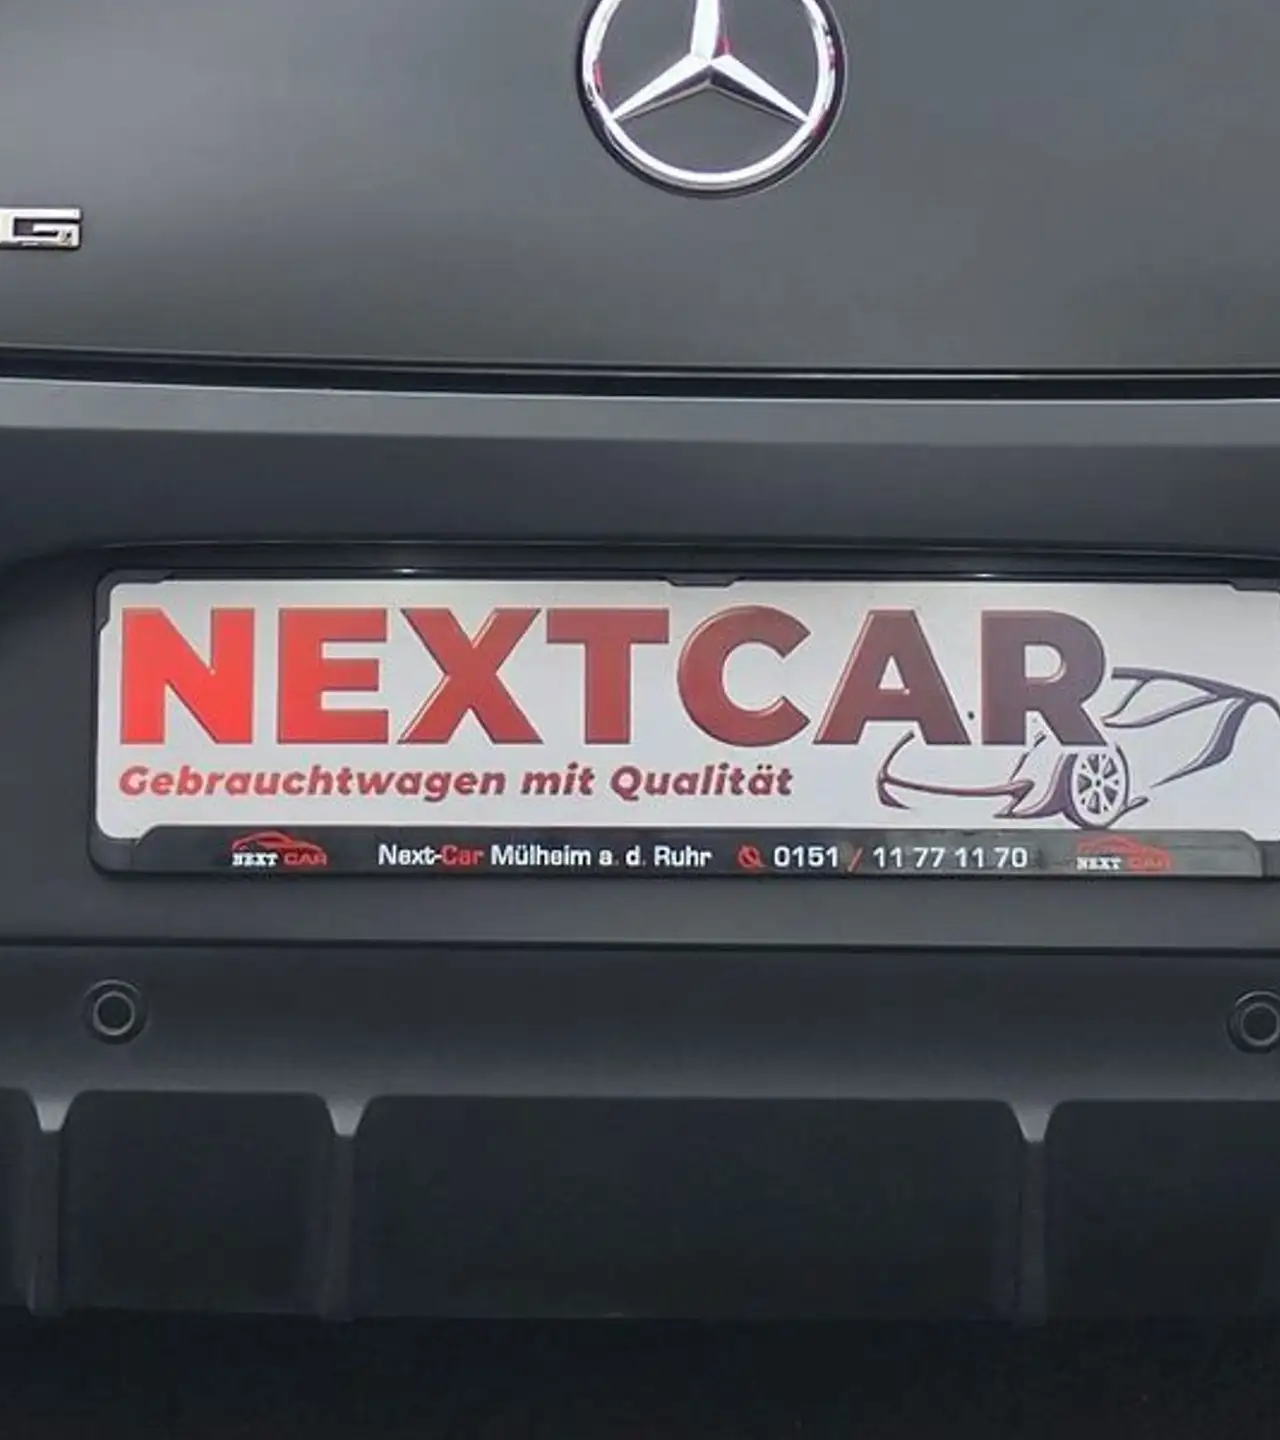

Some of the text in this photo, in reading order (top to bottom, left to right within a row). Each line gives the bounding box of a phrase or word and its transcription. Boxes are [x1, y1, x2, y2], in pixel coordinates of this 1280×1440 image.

[119, 604, 1108, 747] NEXTCAR
[119, 761, 793, 802] Gebrauchtwagen mit Qualität
[231, 852, 328, 867] NEXT CAR
[490, 844, 592, 867] Mülheim
[653, 844, 713, 867] Ruhr
[773, 845, 839, 868] 0151
[873, 846, 904, 868] 11
[913, 846, 947, 868] 77
[954, 847, 984, 868] 11
[993, 847, 1028, 869] 70
